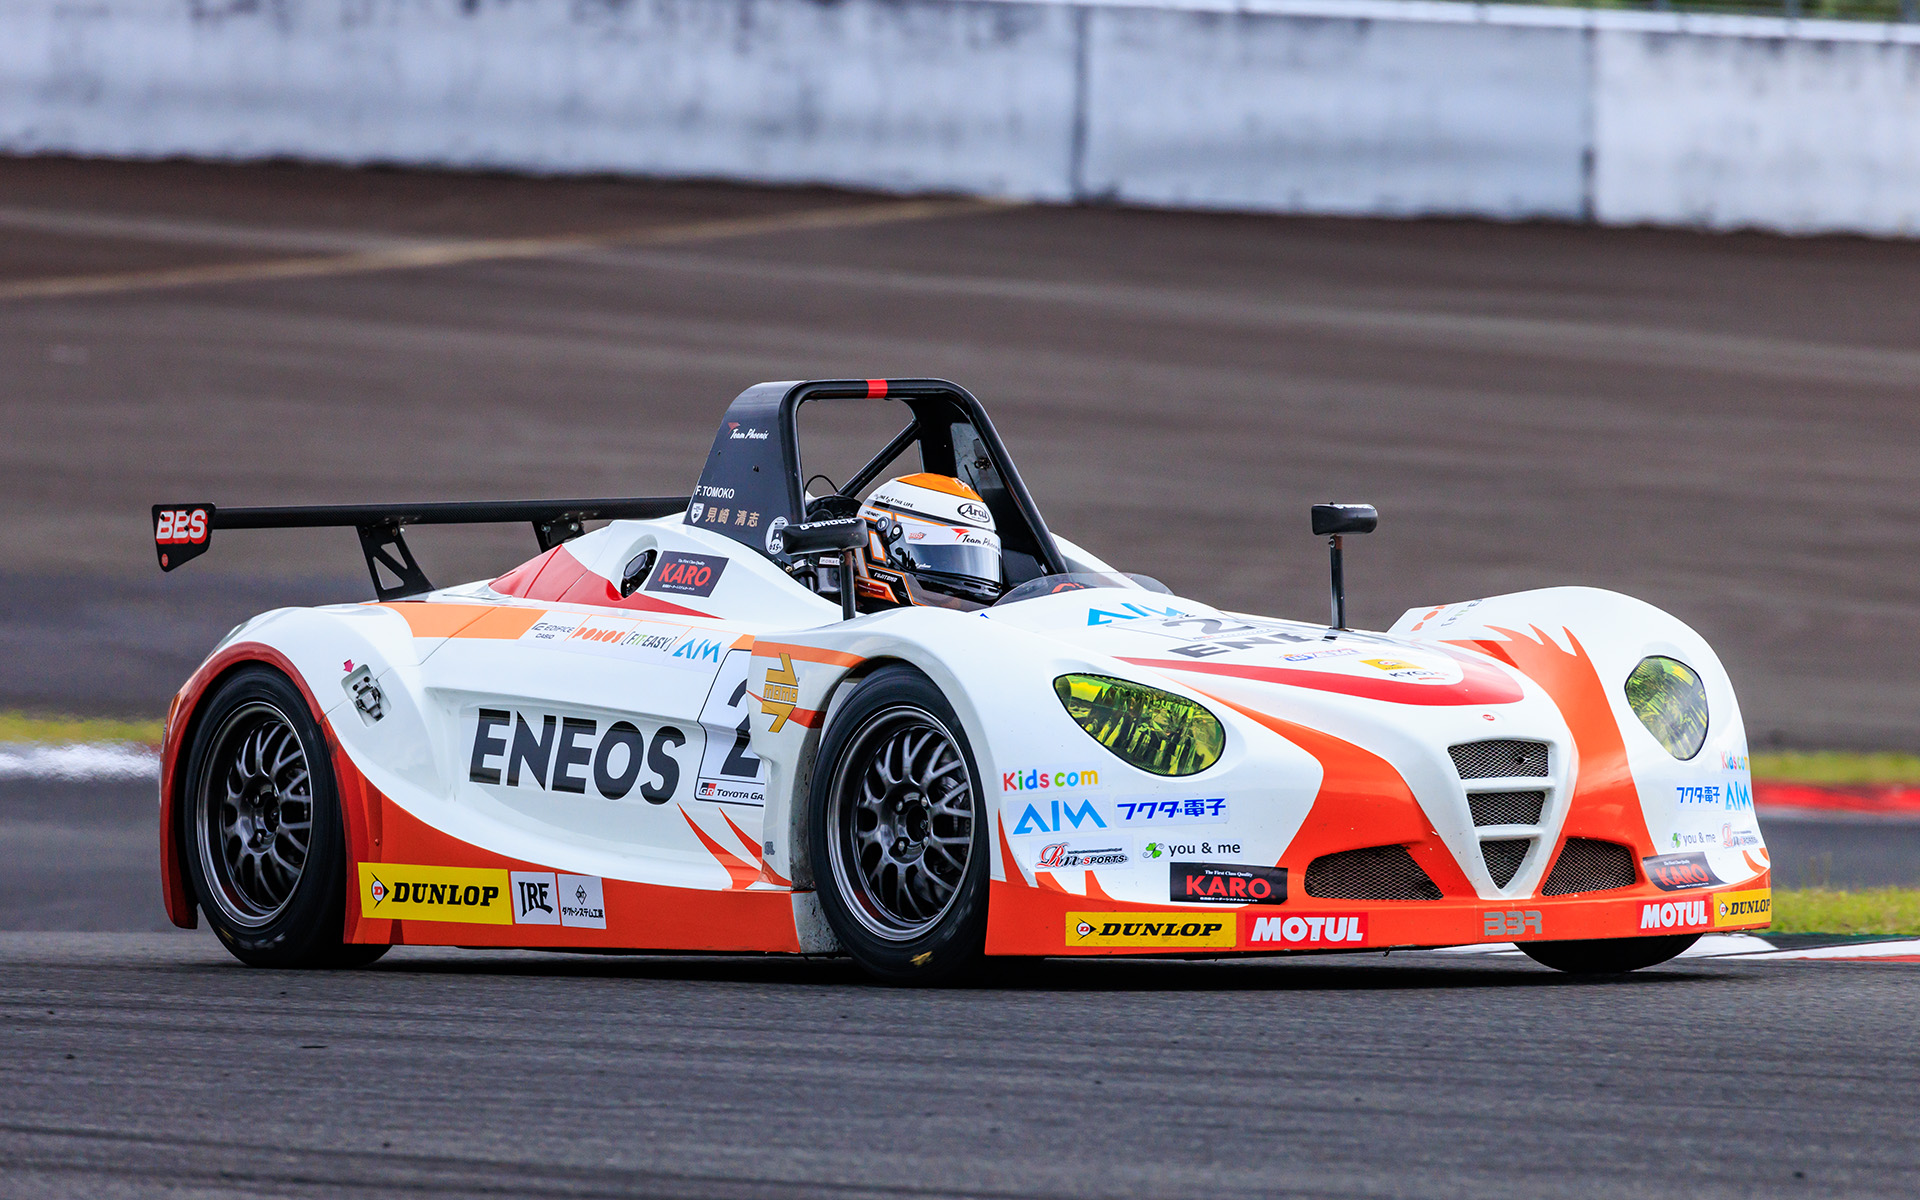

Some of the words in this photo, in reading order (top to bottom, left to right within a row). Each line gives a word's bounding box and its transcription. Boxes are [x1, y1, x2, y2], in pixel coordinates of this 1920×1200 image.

[695, 485, 735, 499] F.TOMOKO
[960, 504, 988, 519] Arai
[156, 509, 207, 543] BBS
[962, 534, 982, 545] Team
[658, 563, 711, 586] KARO
[571, 627, 625, 643] PONOS
[672, 638, 722, 663] AIM
[763, 683, 798, 703] momo
[720, 678, 760, 778] 2
[469, 708, 686, 805] ENEOS
[1003, 769, 1050, 791] Kids
[1054, 769, 1098, 788] com
[699, 783, 717, 797] GR
[717, 788, 749, 799] TOYOTA
[750, 792, 765, 801] GA
[1725, 781, 1753, 811] AIM
[1012, 799, 1108, 835] AIM
[1117, 798, 1226, 820] フクダ電子
[1168, 844, 1196, 857] you
[1201, 842, 1213, 854] &
[1217, 842, 1241, 854] me
[1683, 833, 1697, 847] you
[1698, 832, 1705, 844] &
[1705, 833, 1716, 843] me
[1655, 864, 1709, 886] KARO
[392, 882, 499, 907] DUNLOP
[1186, 875, 1272, 899] KARO
[1641, 901, 1708, 929] MOTUL
[1730, 899, 1770, 915] DUNLOP
[1099, 922, 1222, 936] DUNLOP
[1251, 917, 1363, 942] MOTUL
